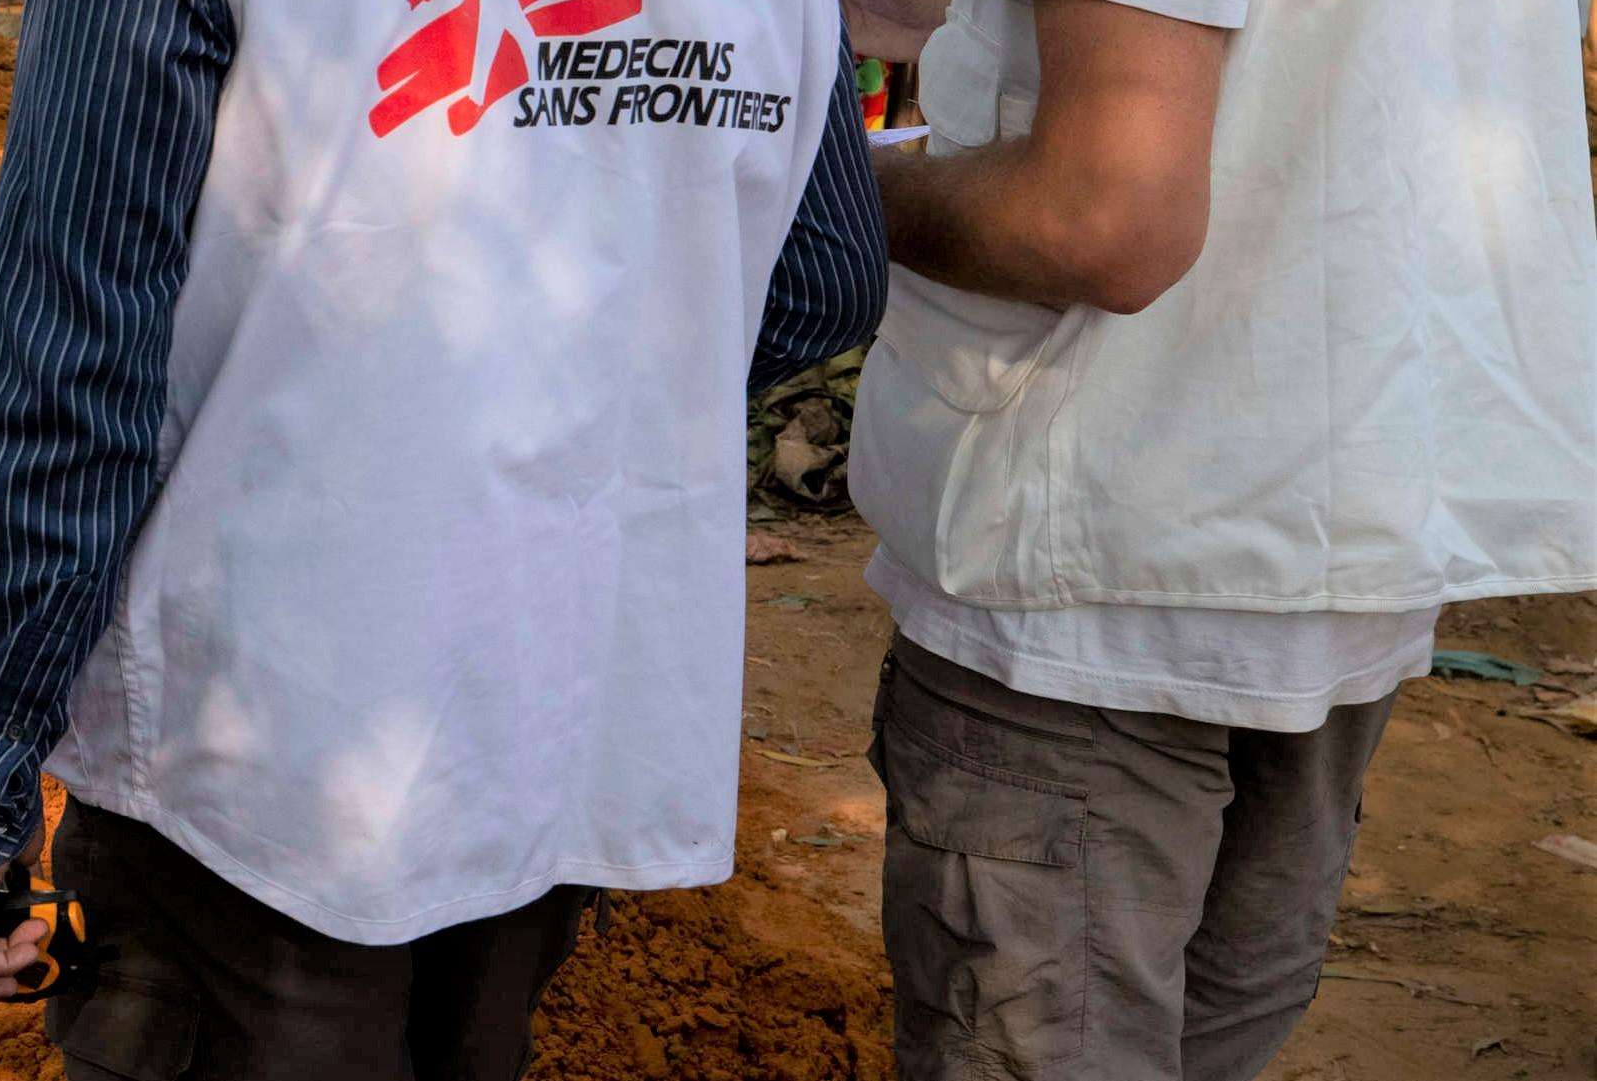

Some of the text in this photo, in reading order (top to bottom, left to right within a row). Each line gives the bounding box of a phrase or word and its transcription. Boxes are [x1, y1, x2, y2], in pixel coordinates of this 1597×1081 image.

[538, 38, 735, 83] MEDECINS
[513, 83, 792, 133] SANS FRONTIERES
